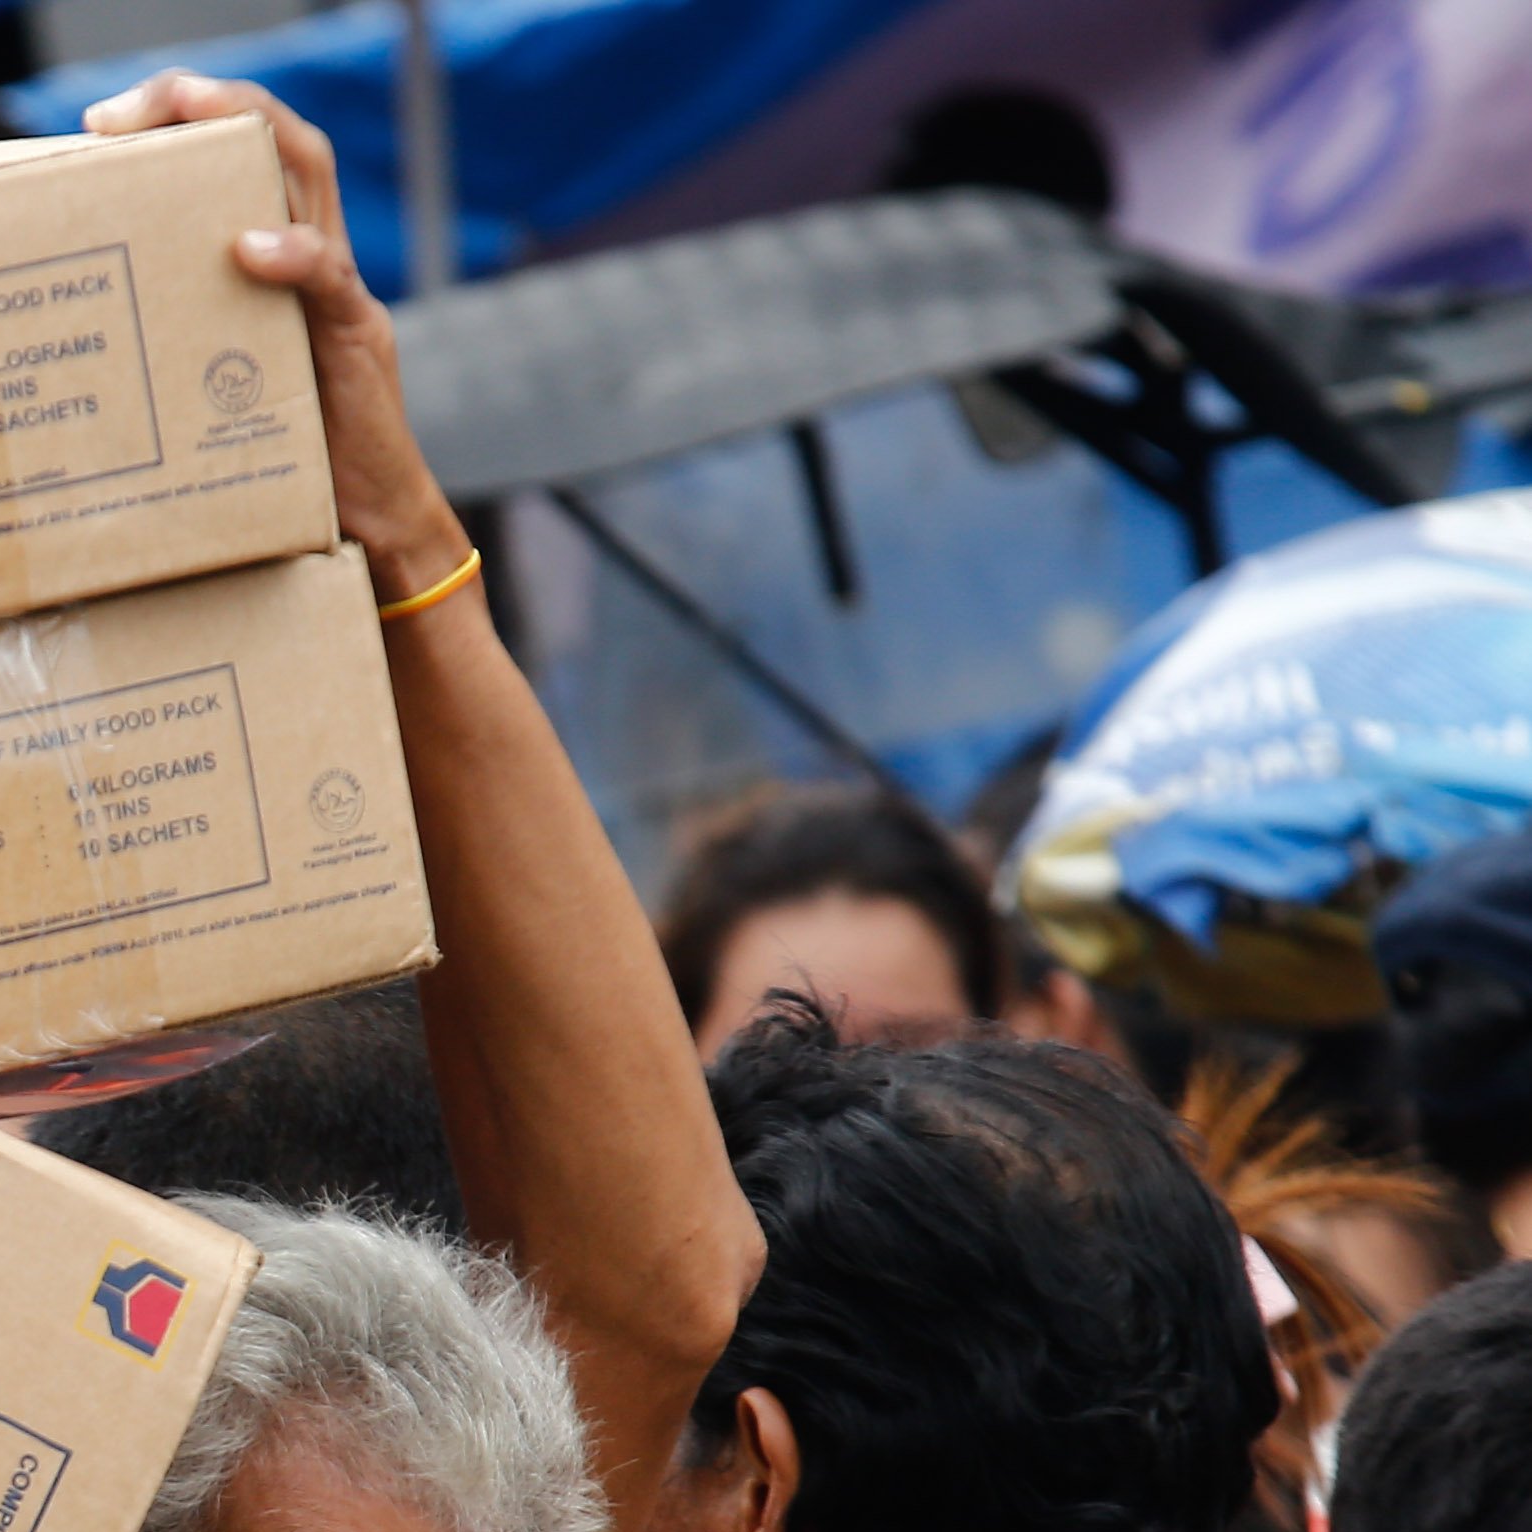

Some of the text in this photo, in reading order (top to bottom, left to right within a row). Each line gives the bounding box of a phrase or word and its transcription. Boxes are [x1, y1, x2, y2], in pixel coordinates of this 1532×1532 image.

[50, 273, 112, 302] PACK
[11, 722, 87, 756] FAMILY
[94, 707, 156, 738] FOOD
[162, 693, 221, 721] PACK
[66, 782, 79, 802] 6
[87, 750, 216, 796] KILOGRAMS
[72, 808, 96, 830] 10
[101, 795, 151, 822] TINS
[77, 838, 101, 860] 10
[106, 813, 210, 853] SACHETS
